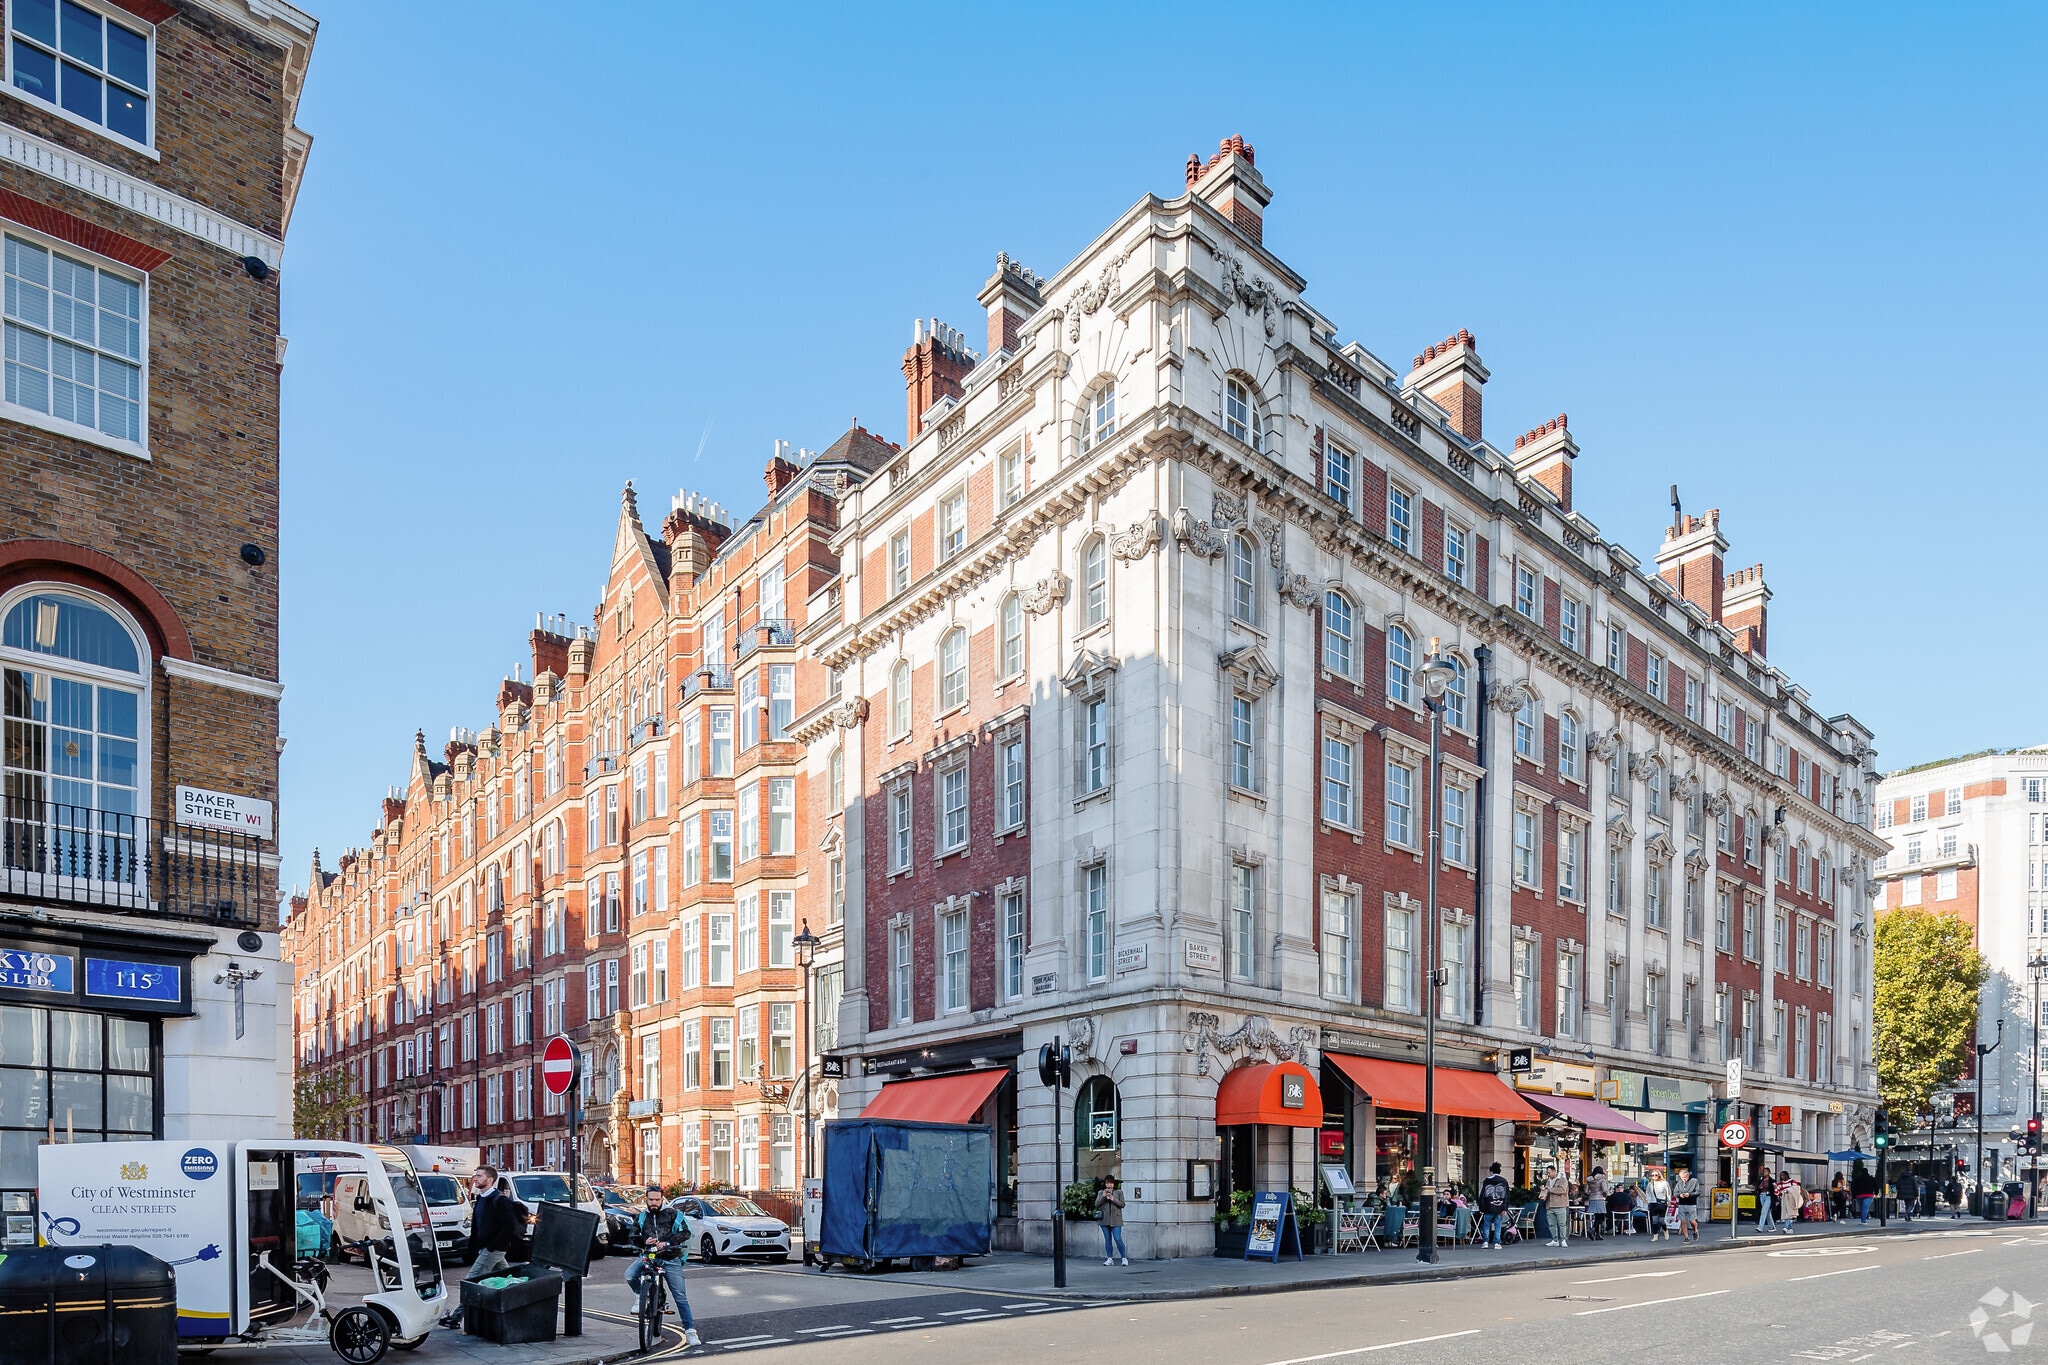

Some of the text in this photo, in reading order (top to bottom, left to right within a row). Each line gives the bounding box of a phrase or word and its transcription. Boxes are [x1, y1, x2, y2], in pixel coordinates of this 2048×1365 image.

[184, 791, 235, 809] BAKER
[184, 804, 261, 826] STREET W1
[1189, 944, 1208, 953] BAKER
[1118, 956, 1133, 965] STREET
[1189, 952, 1210, 961] STREET
[13, 973, 56, 987] LTD.
[116, 971, 152, 990] 115
[1341, 1038, 1367, 1047] RESTAURANT
[1650, 1087, 1680, 1101] Robert Dyas
[1726, 1129, 1745, 1140] 20
[184, 1156, 214, 1165] ZERO
[71, 1186, 196, 1202] City of Westminster
[91, 1205, 177, 1214] CLEAN STREETS
